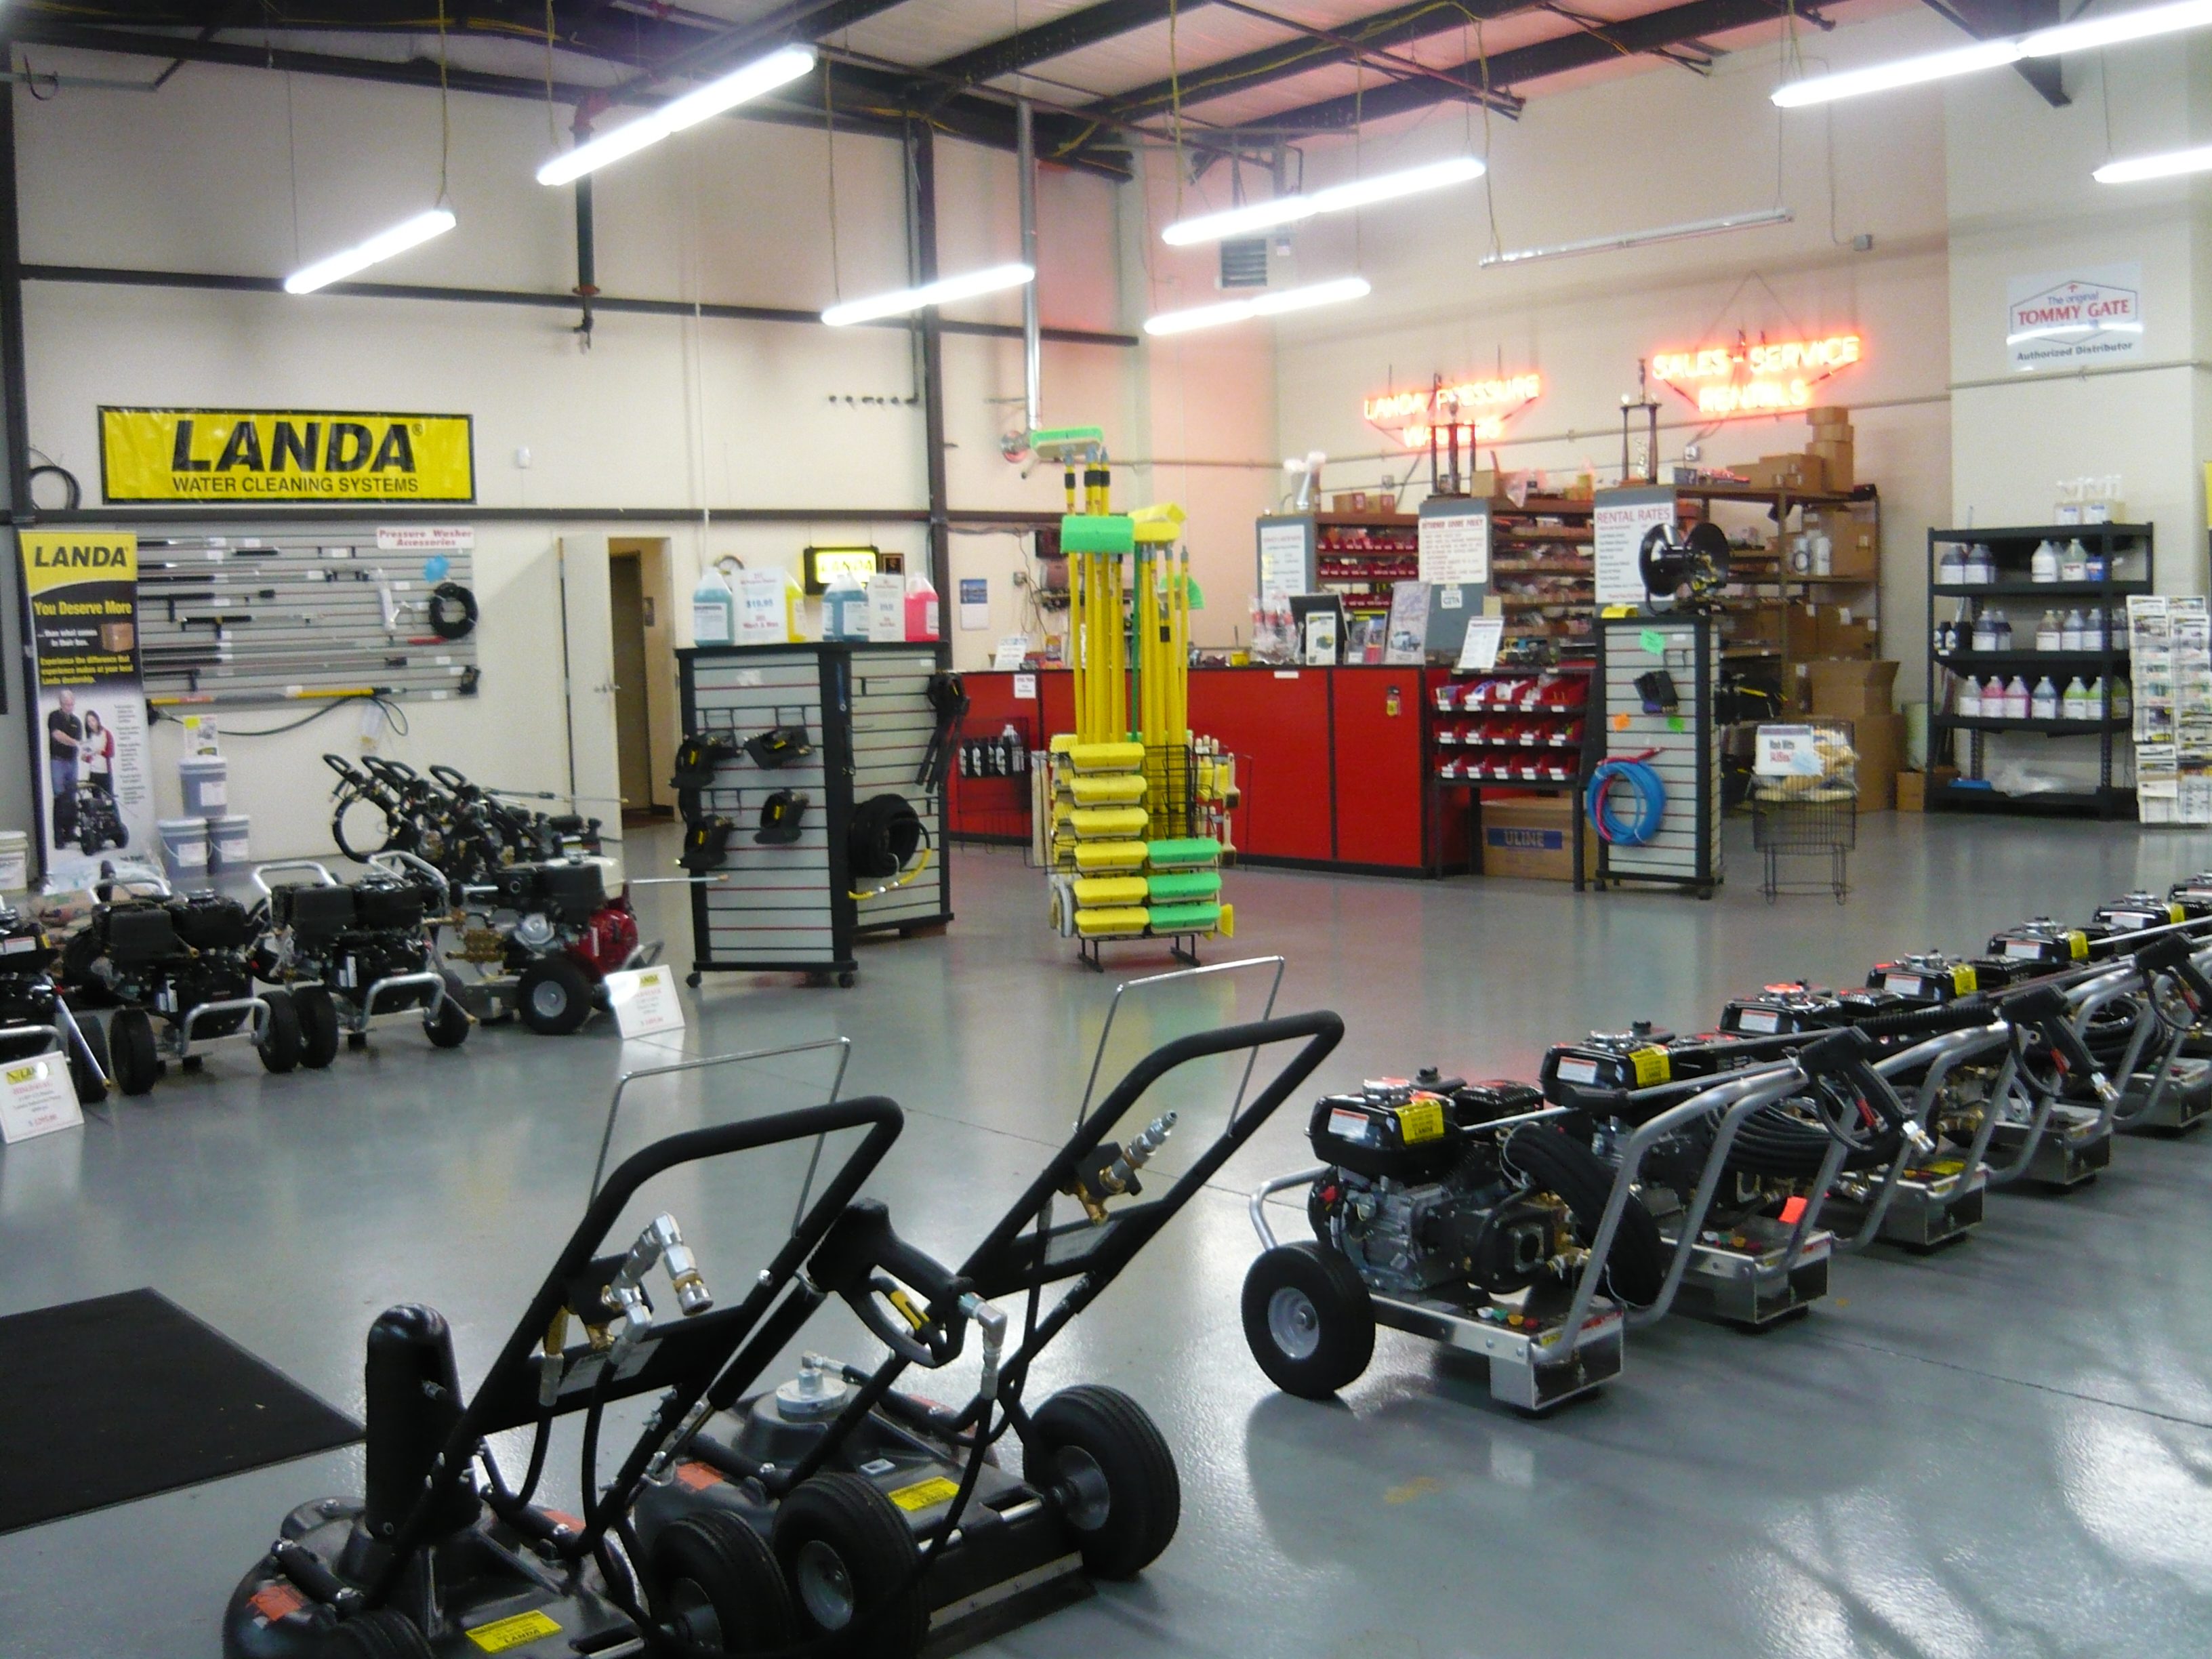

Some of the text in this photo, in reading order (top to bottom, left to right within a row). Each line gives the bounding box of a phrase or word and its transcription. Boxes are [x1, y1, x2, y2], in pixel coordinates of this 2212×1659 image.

[2047, 291, 2100, 305] The original
[2018, 306, 2081, 325] TOMMY
[2087, 299, 2131, 318] GATE
[1652, 348, 1729, 380] SALES
[1749, 336, 1860, 373] SERVICE
[2017, 342, 2133, 361] Authorized Distributor
[1698, 378, 1807, 413] RENTALS
[1364, 392, 1427, 420] LANDA
[173, 477, 418, 492] WATER CLEANING SYSTEMS
[1597, 508, 1671, 524] RENTAL RATES
[35, 546, 127, 567] LANDA
[34, 599, 133, 616] You Deserve More
[1504, 830, 1544, 848] ULINE
